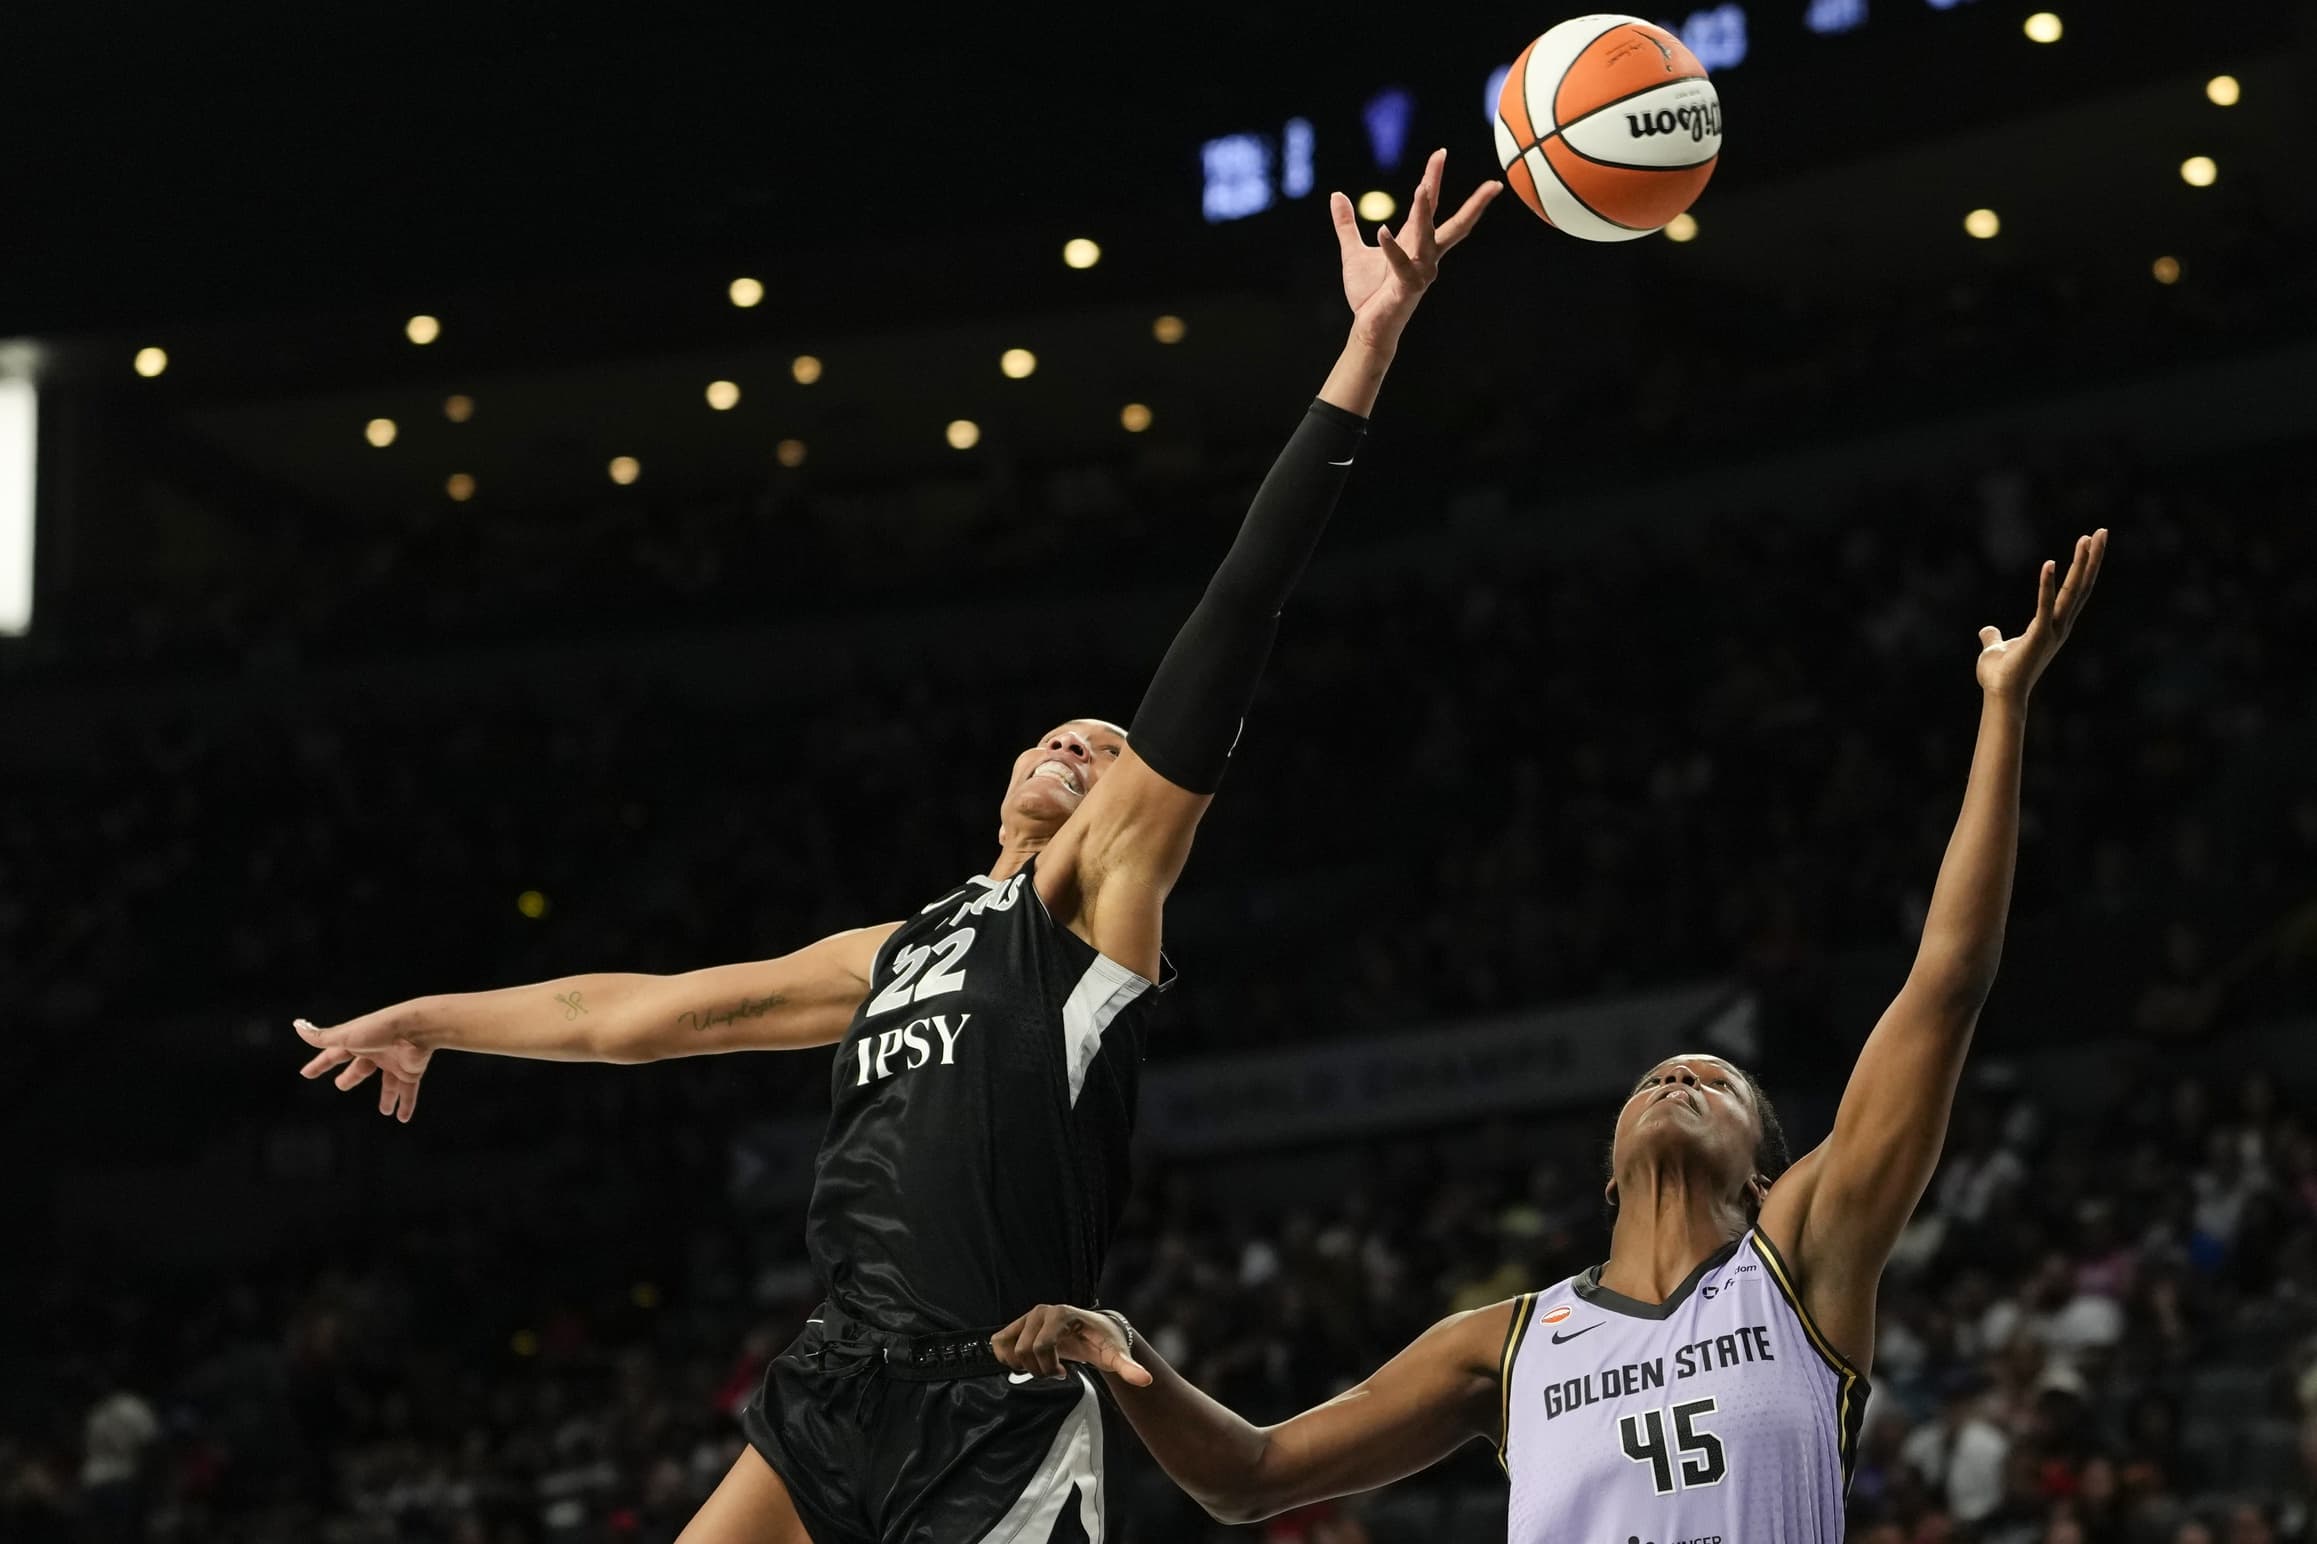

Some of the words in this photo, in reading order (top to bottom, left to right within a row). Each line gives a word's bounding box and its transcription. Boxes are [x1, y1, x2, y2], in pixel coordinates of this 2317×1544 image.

[866, 928, 976, 1017] 22
[857, 1013, 971, 1087] IPSY
[1544, 1357, 1665, 1421] GOLDEN
[1675, 1326, 1775, 1379] STATE
[1617, 1395, 1728, 1496] 45
